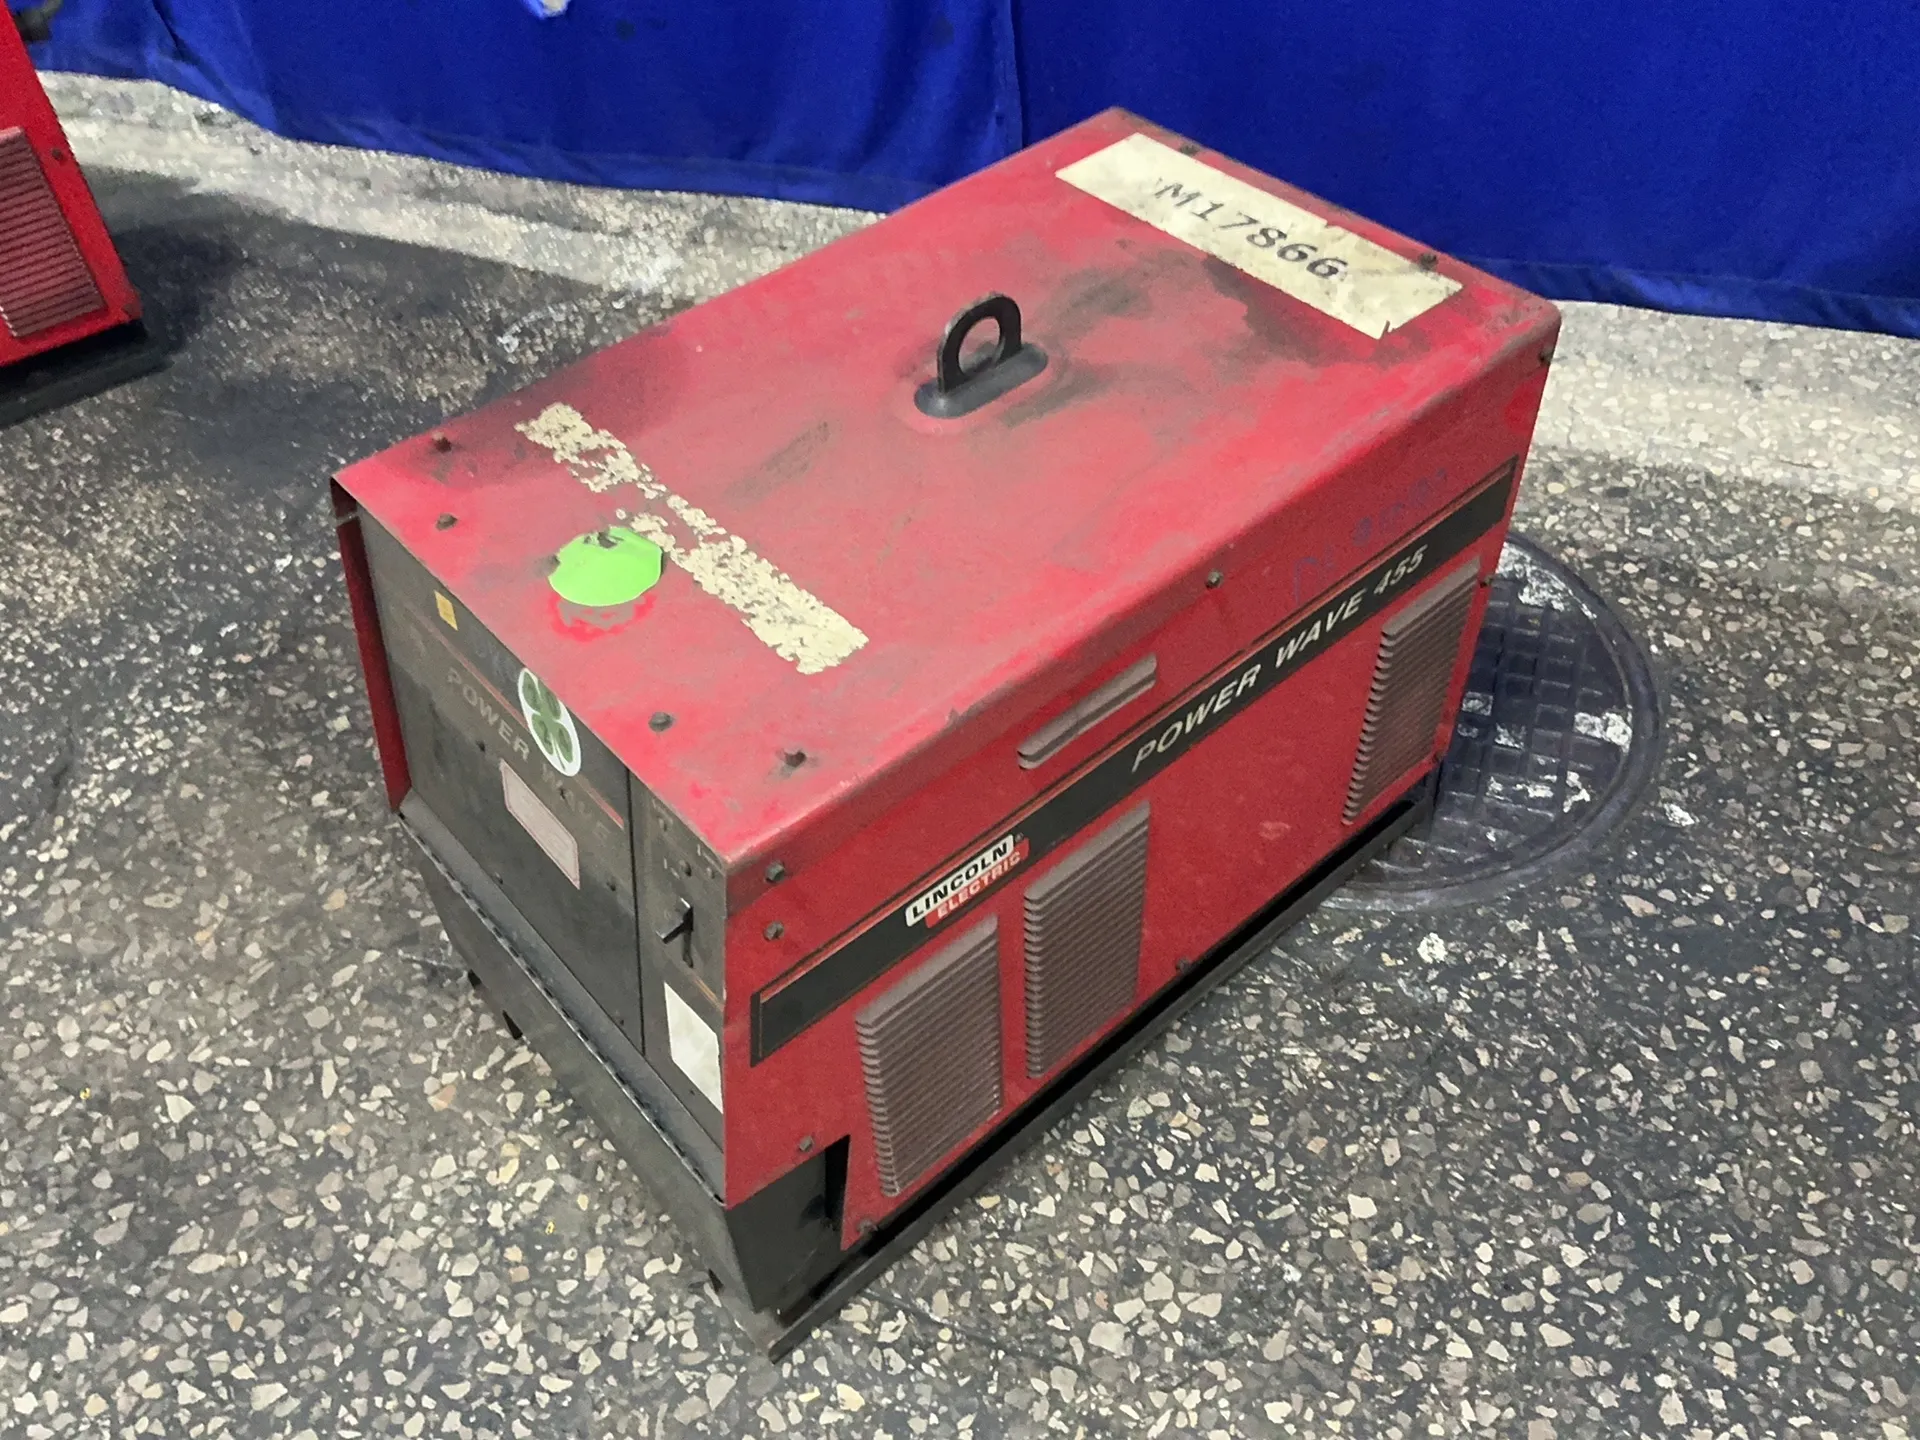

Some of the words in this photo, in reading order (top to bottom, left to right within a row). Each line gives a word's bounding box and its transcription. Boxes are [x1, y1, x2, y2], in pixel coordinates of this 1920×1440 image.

[1154, 179, 1349, 279] M17866
[1130, 664, 1262, 774] POWER
[1274, 593, 1367, 669] WAVE
[1373, 545, 1428, 596] 455
[446, 667, 531, 763] POWER
[911, 841, 1010, 920] LINCOLN
[936, 850, 1022, 920] ELECTRIC
